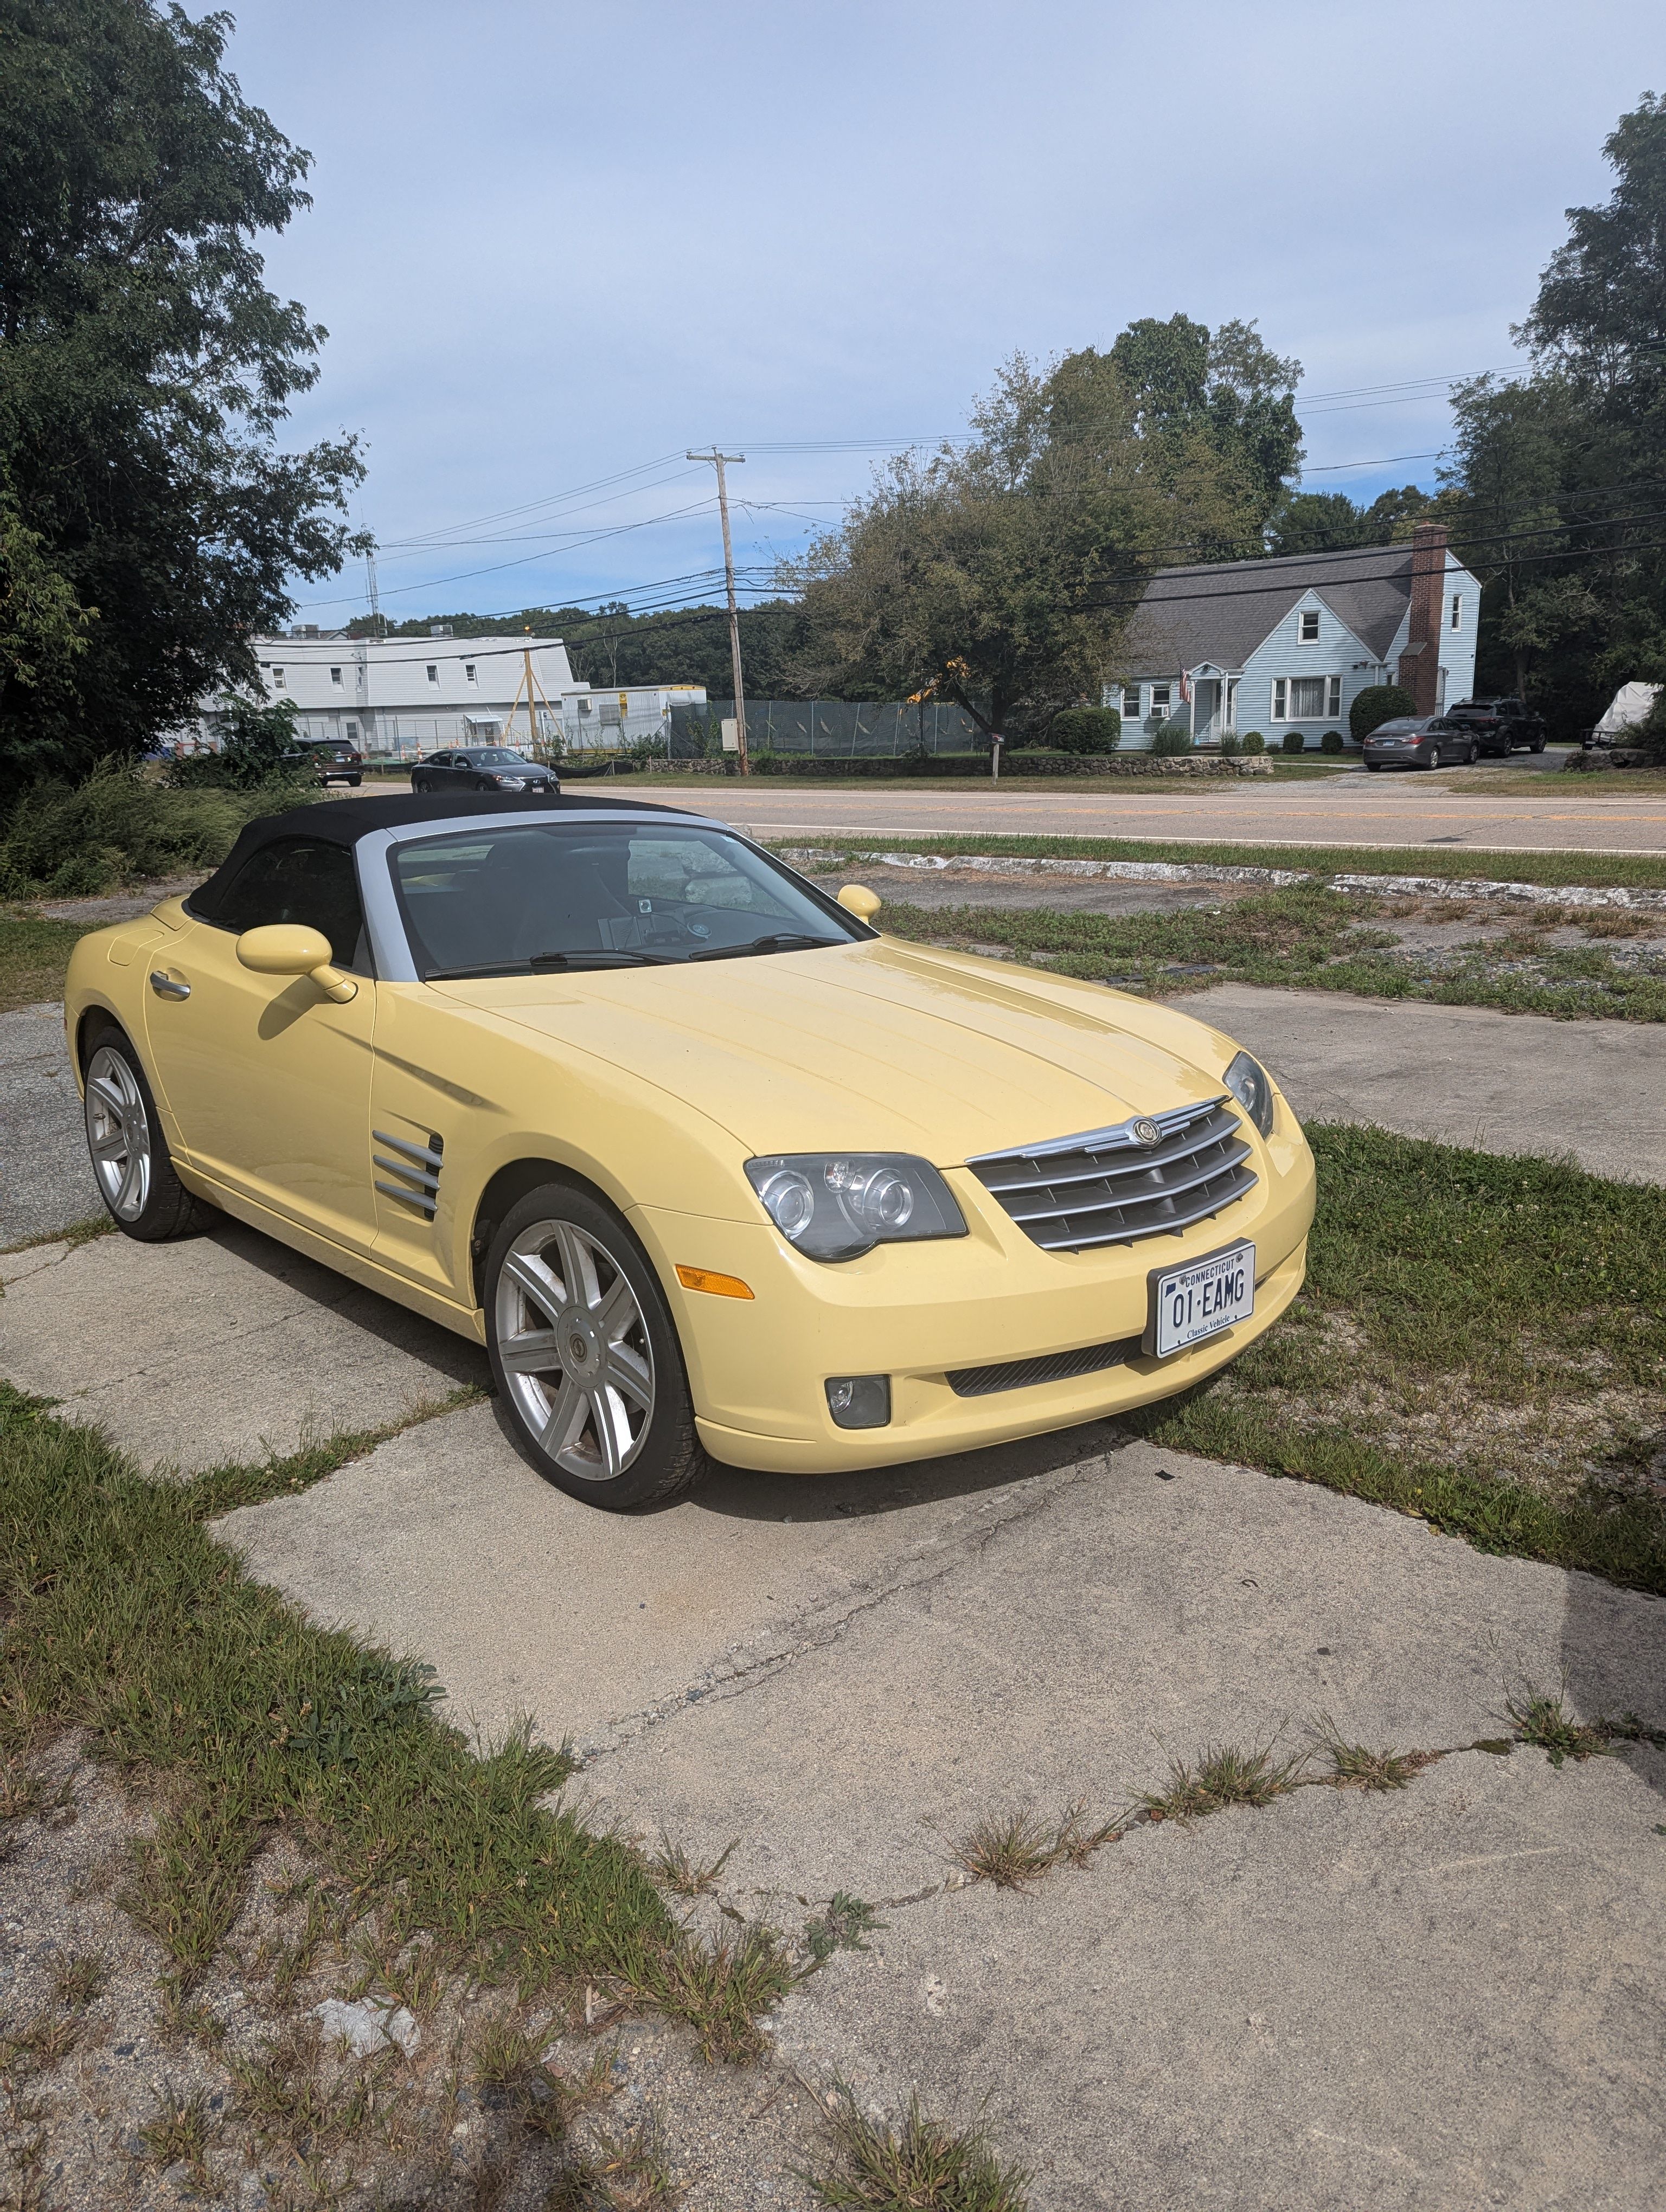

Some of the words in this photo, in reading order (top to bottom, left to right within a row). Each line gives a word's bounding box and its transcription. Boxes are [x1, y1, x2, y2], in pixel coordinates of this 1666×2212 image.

[1186, 1258, 1235, 1288] CONNECTICUT
[1187, 1324, 1208, 1339] Classic
[1209, 1315, 1230, 1329] Vehicle
